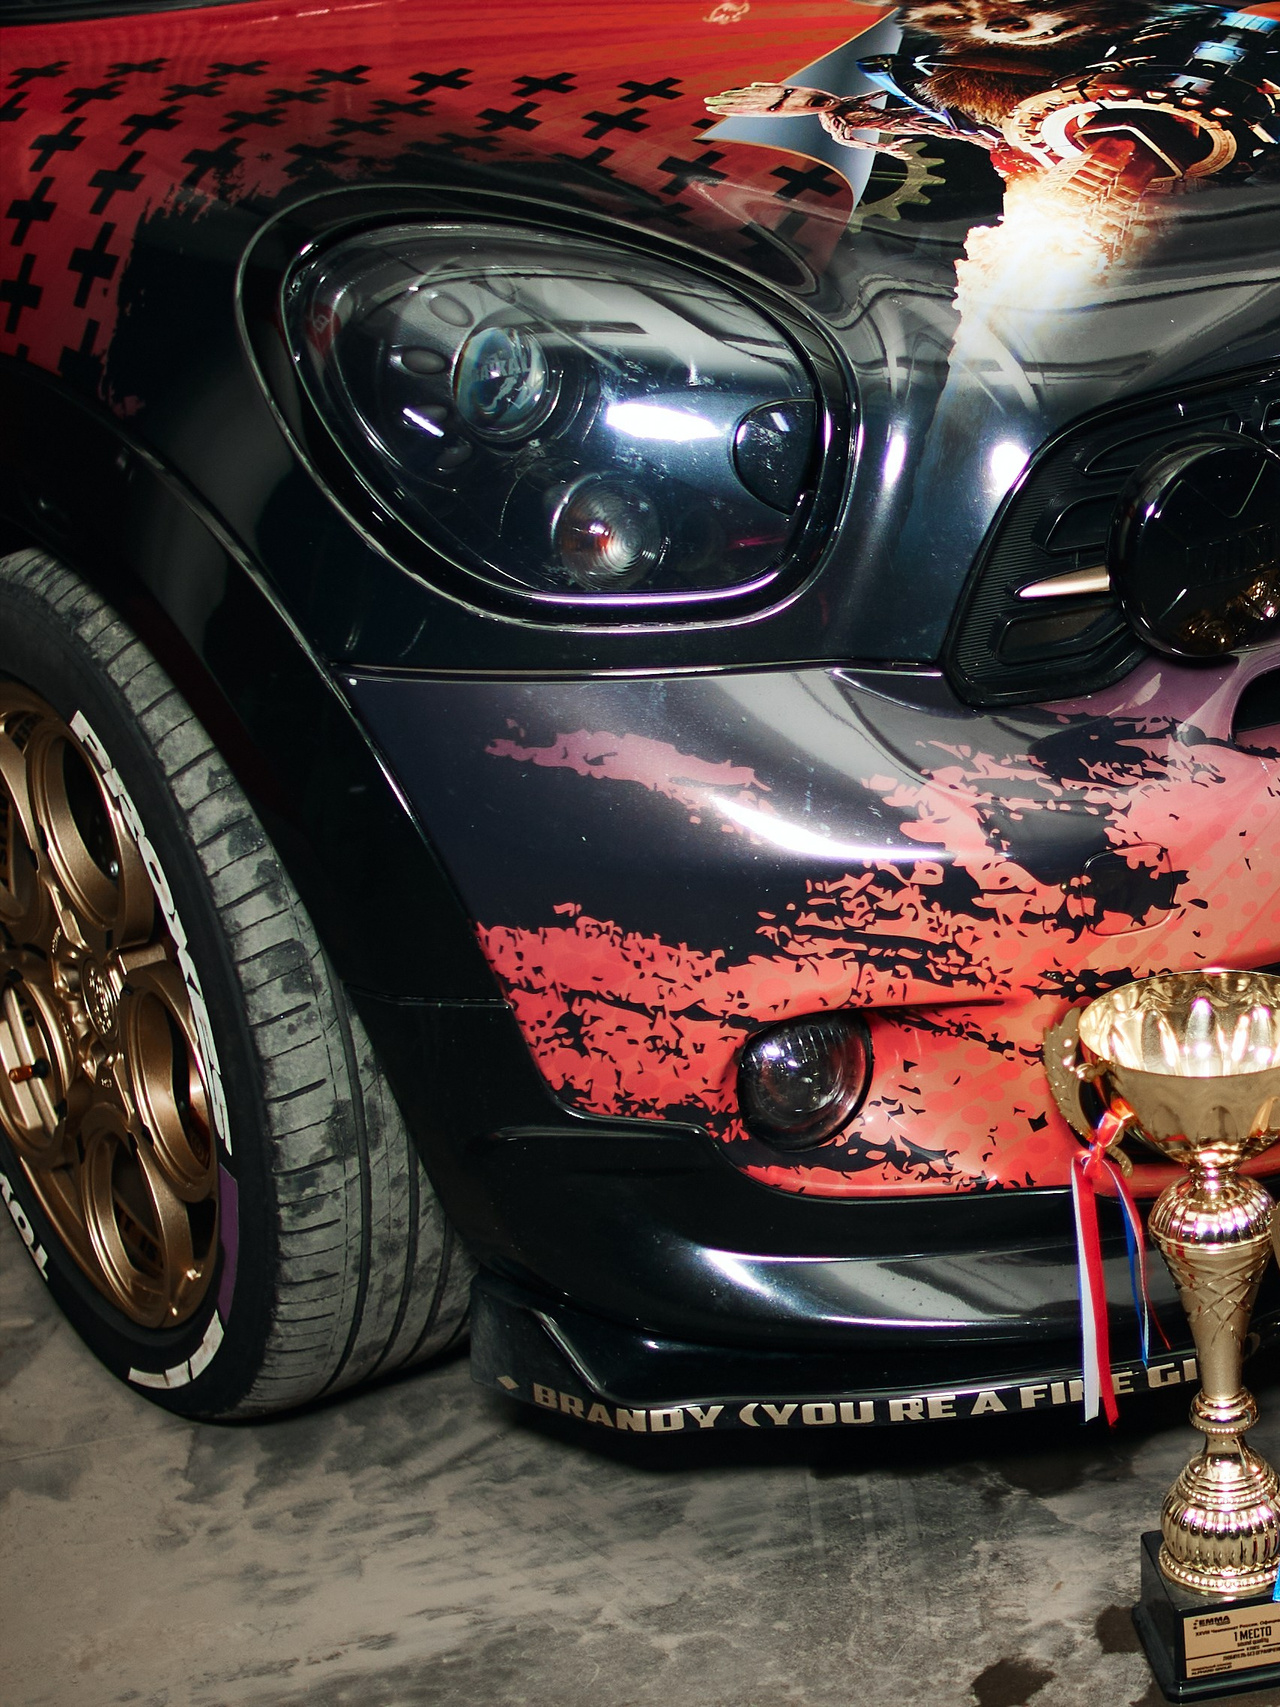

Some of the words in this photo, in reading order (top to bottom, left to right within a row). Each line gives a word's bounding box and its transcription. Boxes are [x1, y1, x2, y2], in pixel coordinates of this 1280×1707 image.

[533, 1382, 724, 1432] BRANDY
[970, 1391, 1007, 1415] A
[1198, 1614, 1230, 1627] EMMA
[1233, 1630, 1238, 1642] 1
[1239, 1625, 1272, 1641] МЕСТО
